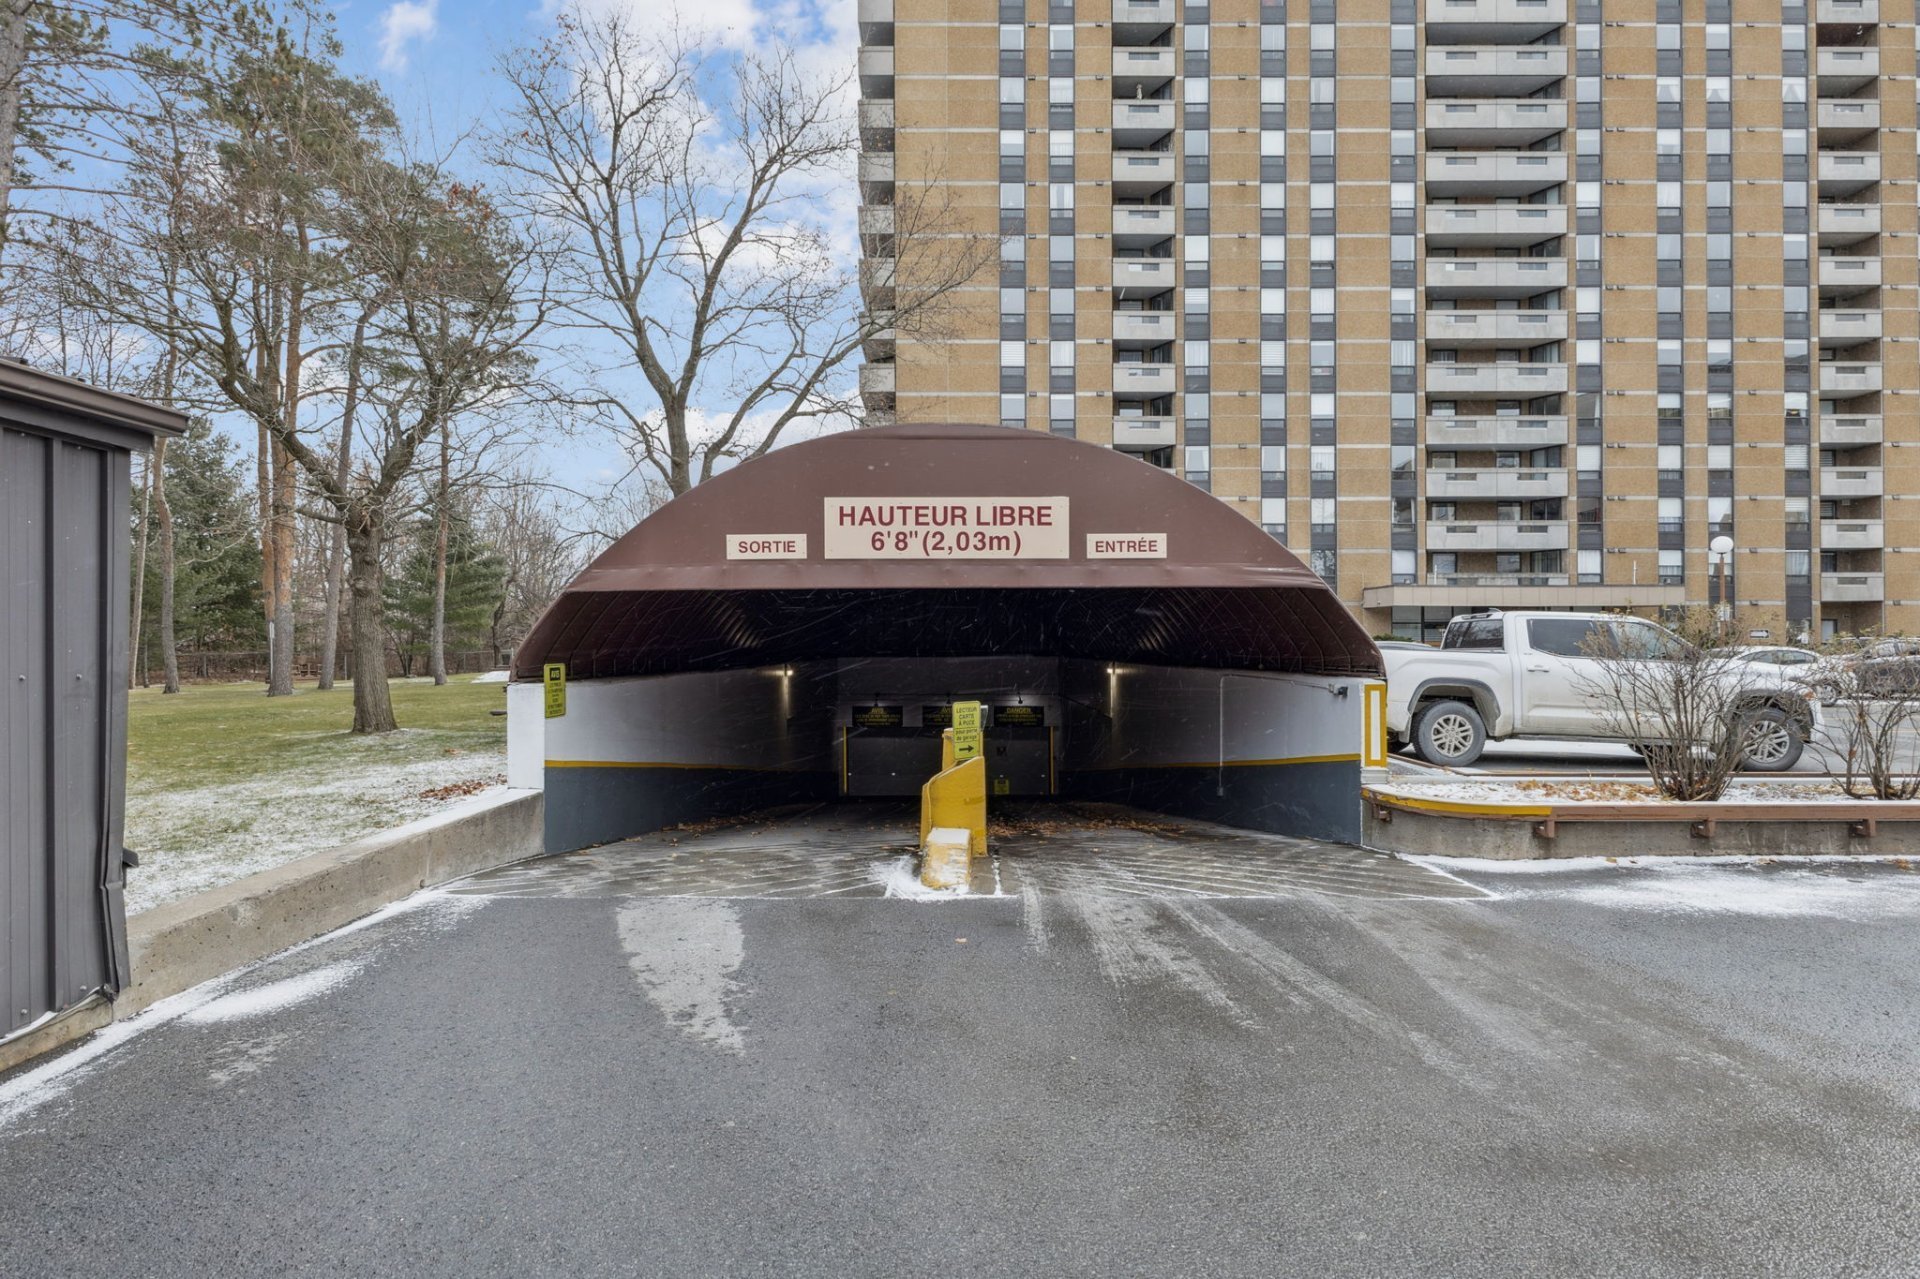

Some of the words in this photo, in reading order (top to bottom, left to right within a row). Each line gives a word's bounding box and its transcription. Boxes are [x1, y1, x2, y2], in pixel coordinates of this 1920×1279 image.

[839, 505, 967, 527] HAUTEUR
[976, 505, 1053, 527] LIBRE
[738, 540, 796, 554] SORTIE
[1095, 537, 1158, 553] ENTRÉE
